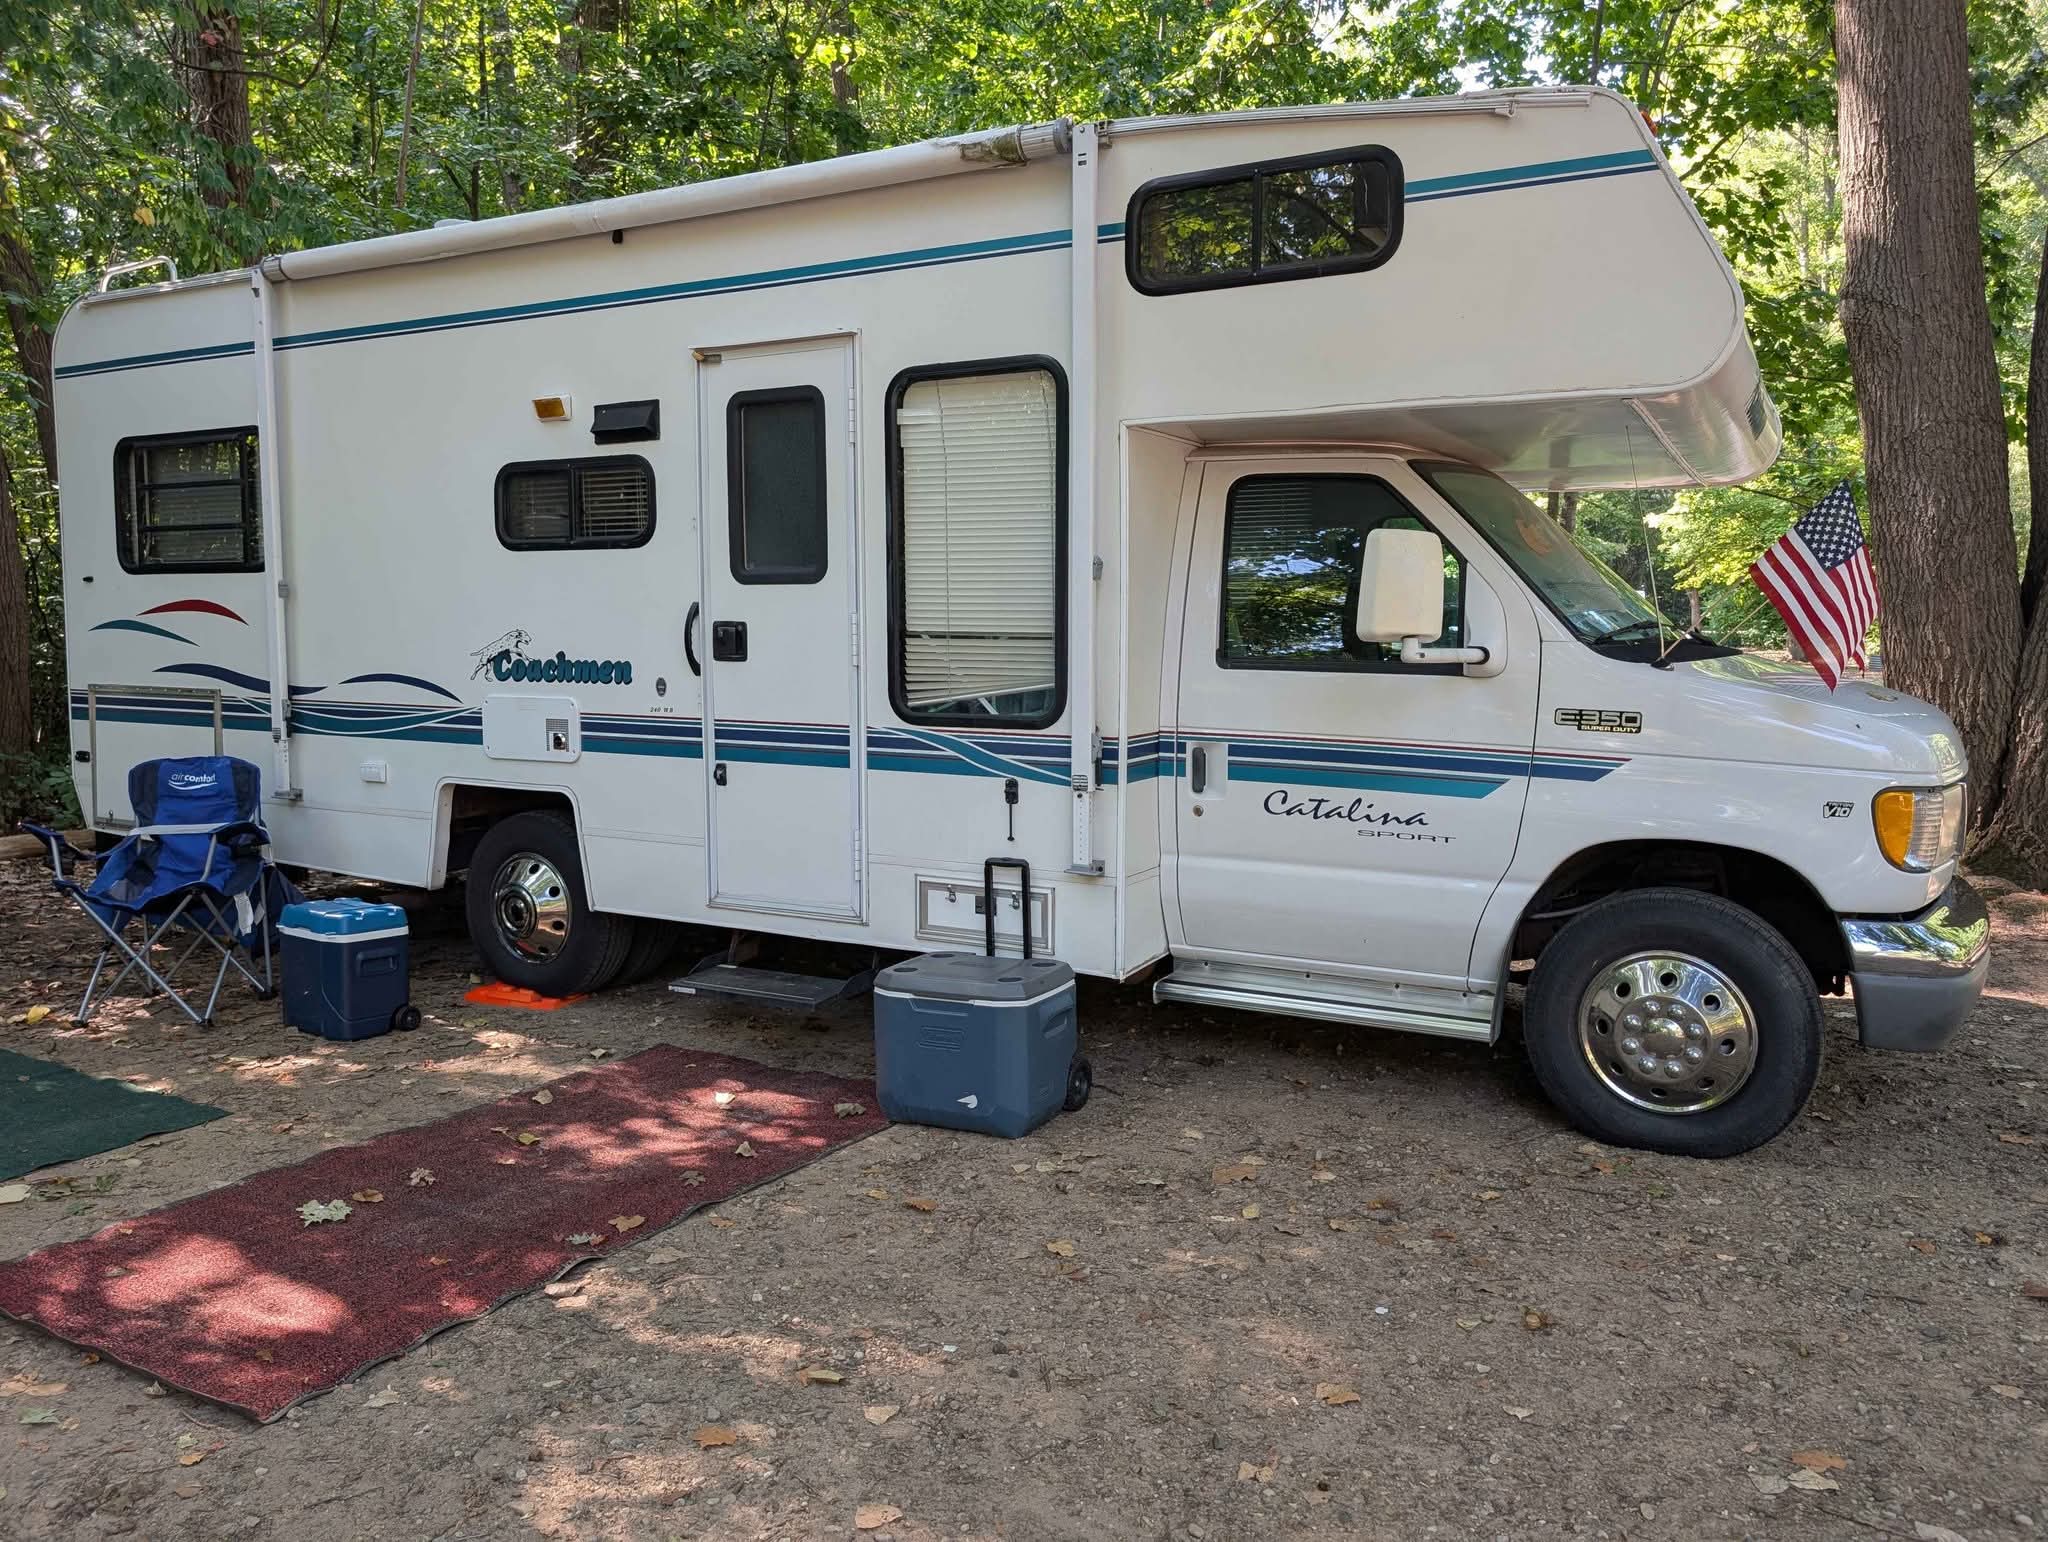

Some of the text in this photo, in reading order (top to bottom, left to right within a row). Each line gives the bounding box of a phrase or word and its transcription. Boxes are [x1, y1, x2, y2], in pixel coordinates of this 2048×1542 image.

[493, 649, 633, 685] Coachmen
[1263, 789, 1429, 826] Catalina
[1823, 805, 1851, 817] V10
[1357, 829, 1457, 844] SPORT
